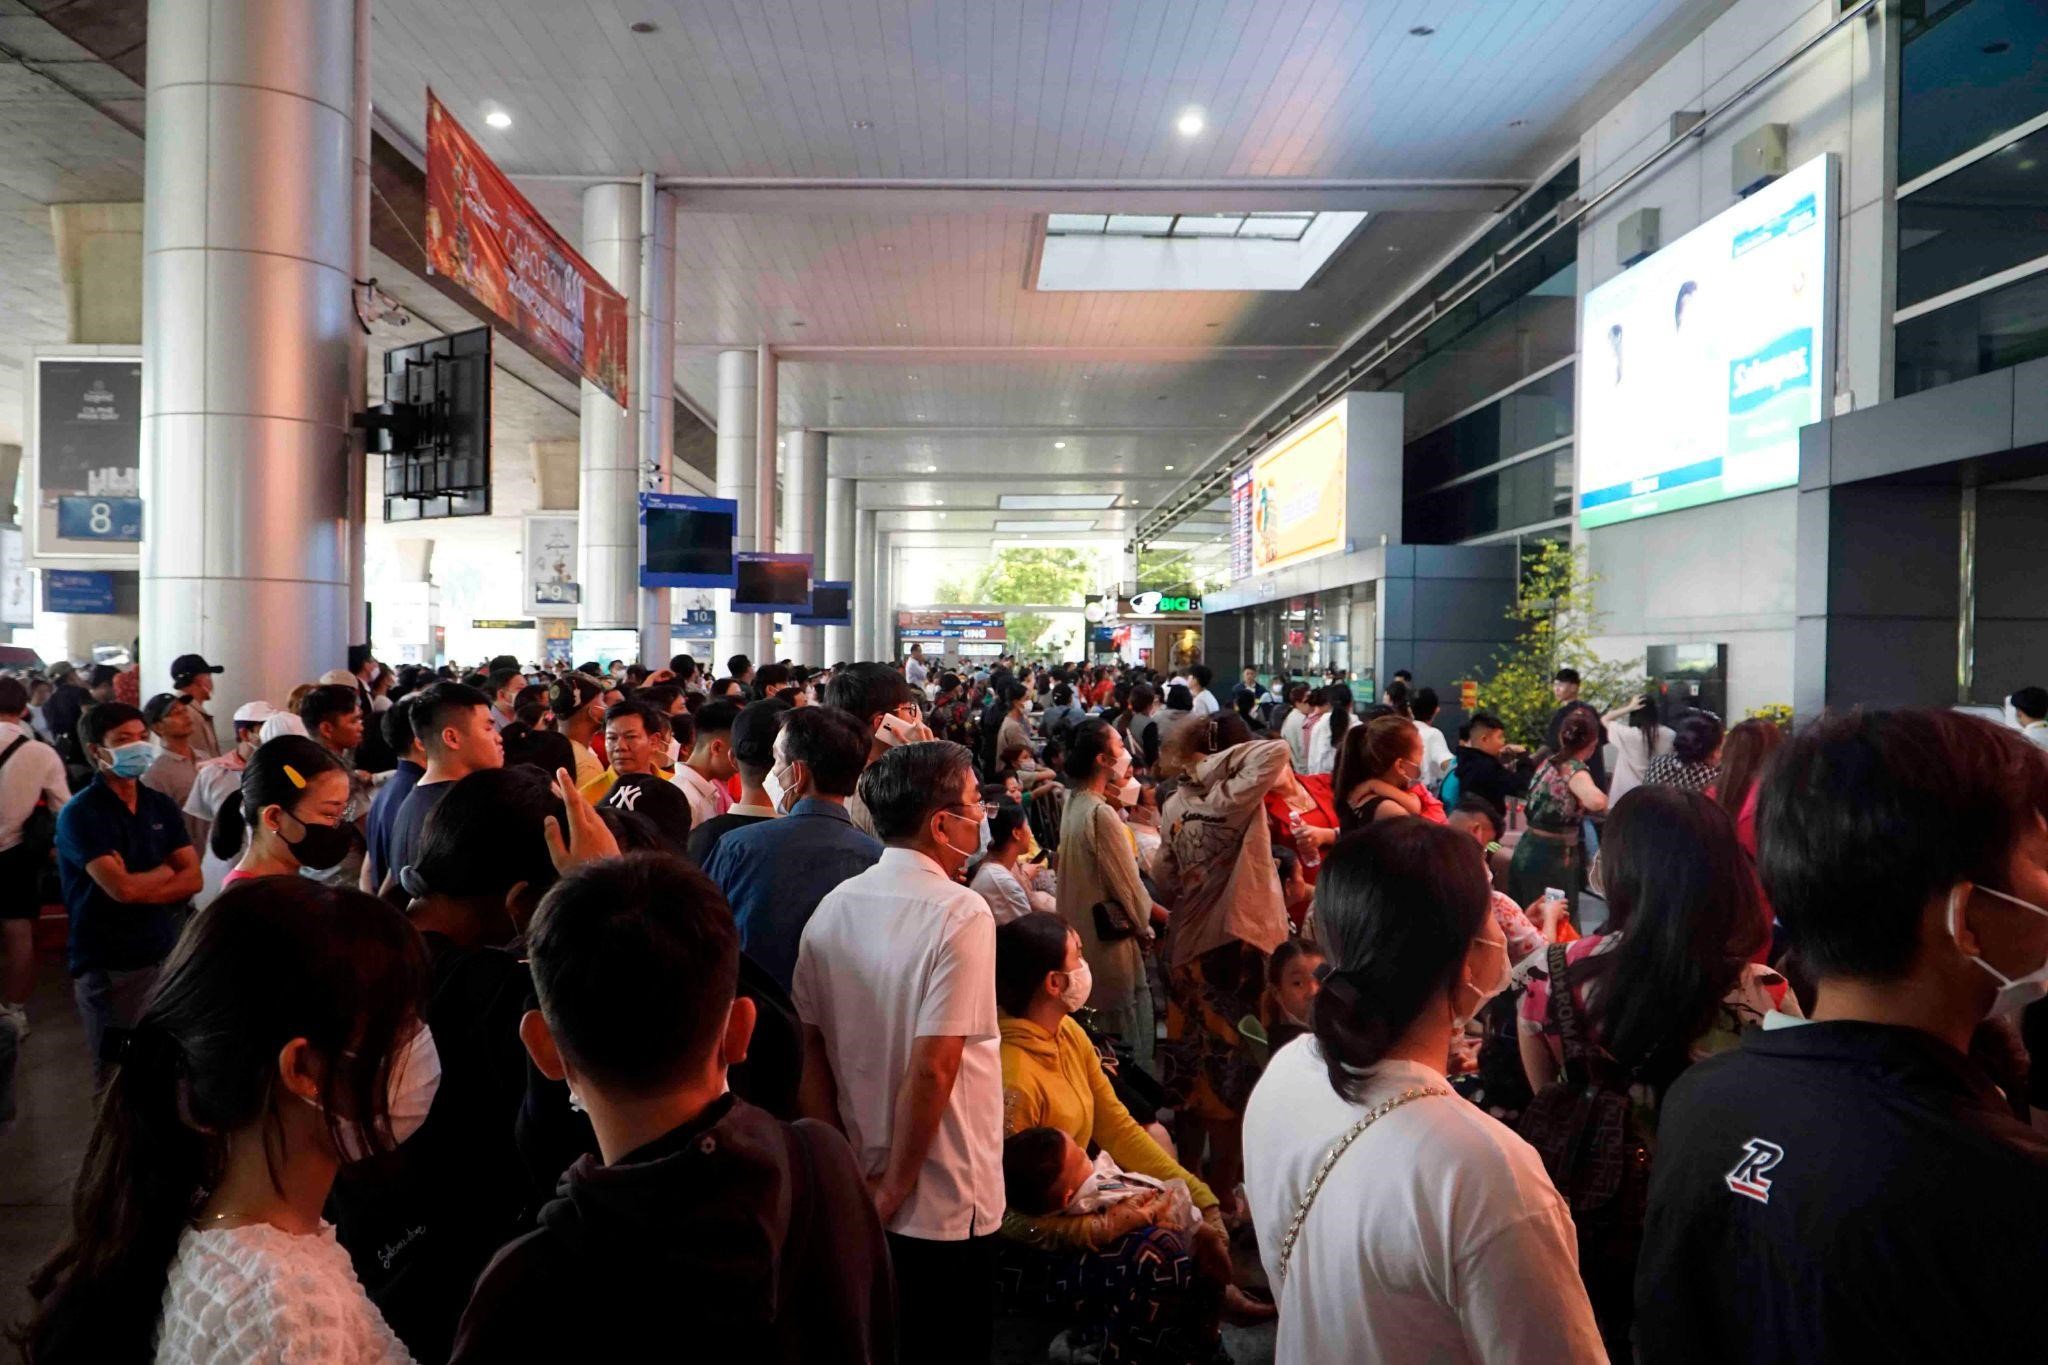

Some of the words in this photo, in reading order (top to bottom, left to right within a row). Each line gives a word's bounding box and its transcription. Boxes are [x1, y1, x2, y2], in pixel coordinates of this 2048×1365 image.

[90, 503, 111, 533] 8
[551, 585, 562, 600] 9
[1160, 597, 1190, 611] BIG
[694, 611, 707, 622] 10
[609, 785, 642, 812] NY
